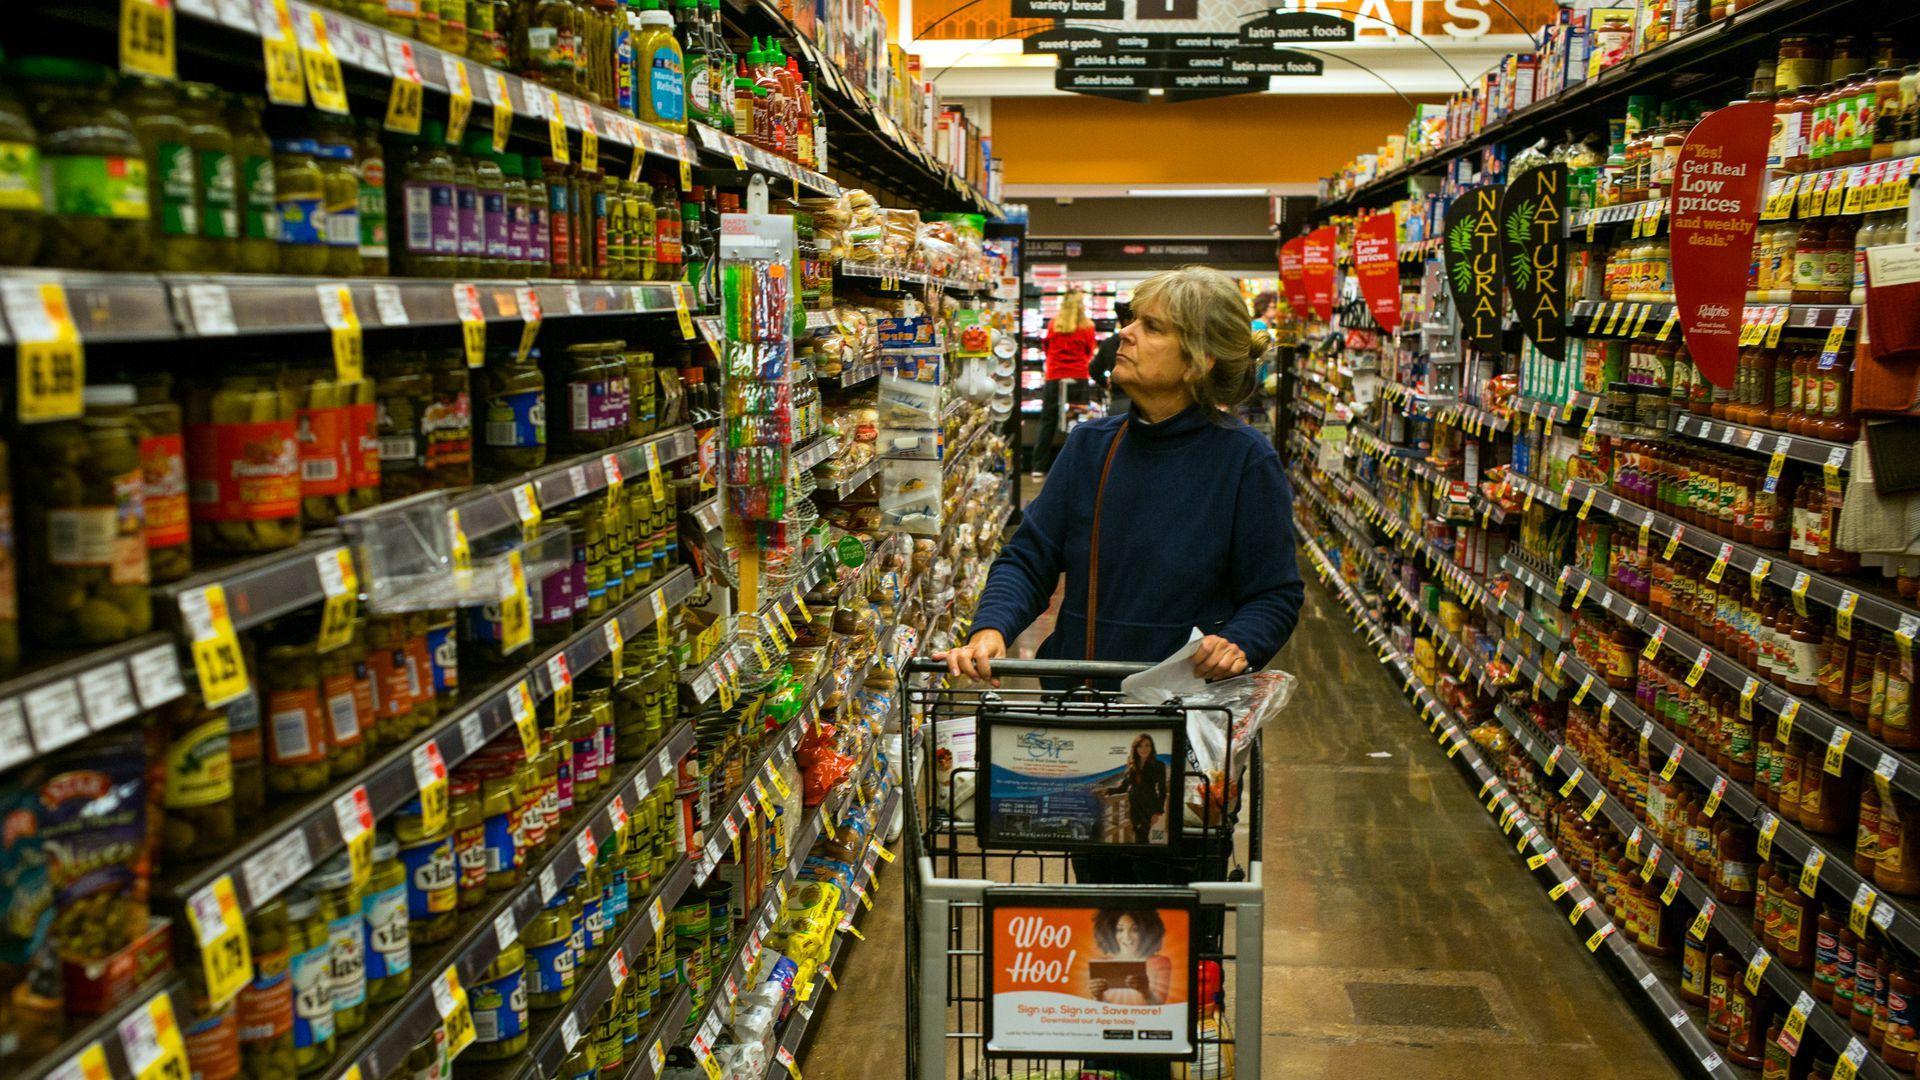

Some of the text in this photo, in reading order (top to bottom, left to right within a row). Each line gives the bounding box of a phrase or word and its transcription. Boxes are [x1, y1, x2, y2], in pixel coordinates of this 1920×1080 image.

[1030, 0, 1106, 13] variety bread
[1248, 26, 1347, 38] latin amer. foods
[1071, 40, 1102, 50] goods
[1176, 38, 1211, 47] canned
[1074, 56, 1107, 66] pickles
[1118, 55, 1146, 65] olives
[1189, 57, 1224, 67] canned
[1232, 61, 1316, 72] latin amer. foods
[1074, 76, 1134, 85] sliced breads
[1176, 76, 1249, 86] spaghetti sauce
[1682, 160, 1747, 177] Get Real
[1680, 174, 1725, 193] Low
[1676, 193, 1741, 215] prices
[1675, 216, 1754, 236] and weekly
[1532, 170, 1560, 343] NATURAL
[1472, 189, 1499, 339] NATURAL
[1008, 916, 1072, 949] Woo
[1006, 949, 1077, 984] Hoo!
[1017, 1004, 1162, 1018] Sign up. Sign on. Save more!
[1040, 1017, 1080, 1025] Download
[1096, 1018, 1112, 1026] App
